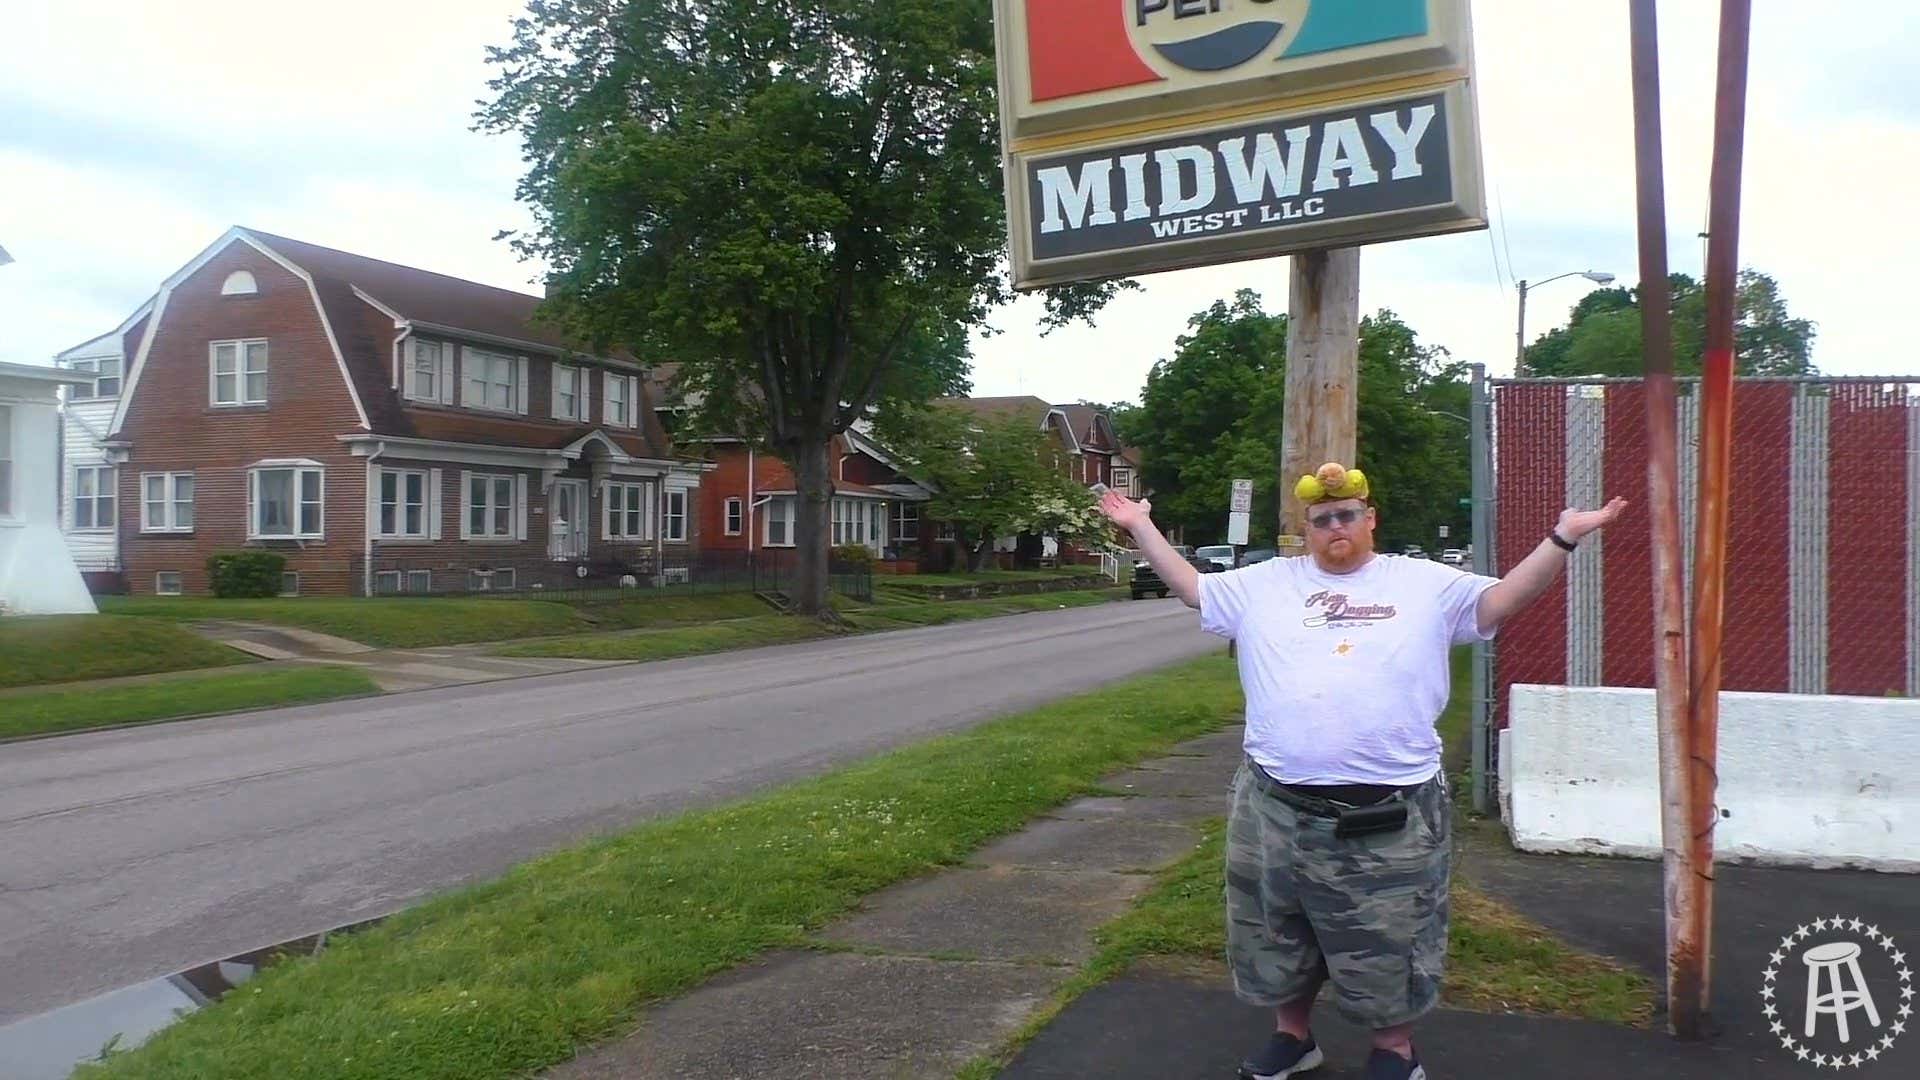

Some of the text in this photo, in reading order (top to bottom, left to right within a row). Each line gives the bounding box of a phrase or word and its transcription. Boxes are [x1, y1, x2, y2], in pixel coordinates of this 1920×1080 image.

[1037, 104, 1435, 233] MIDWAY
[1151, 198, 1324, 238] WEST LLC
